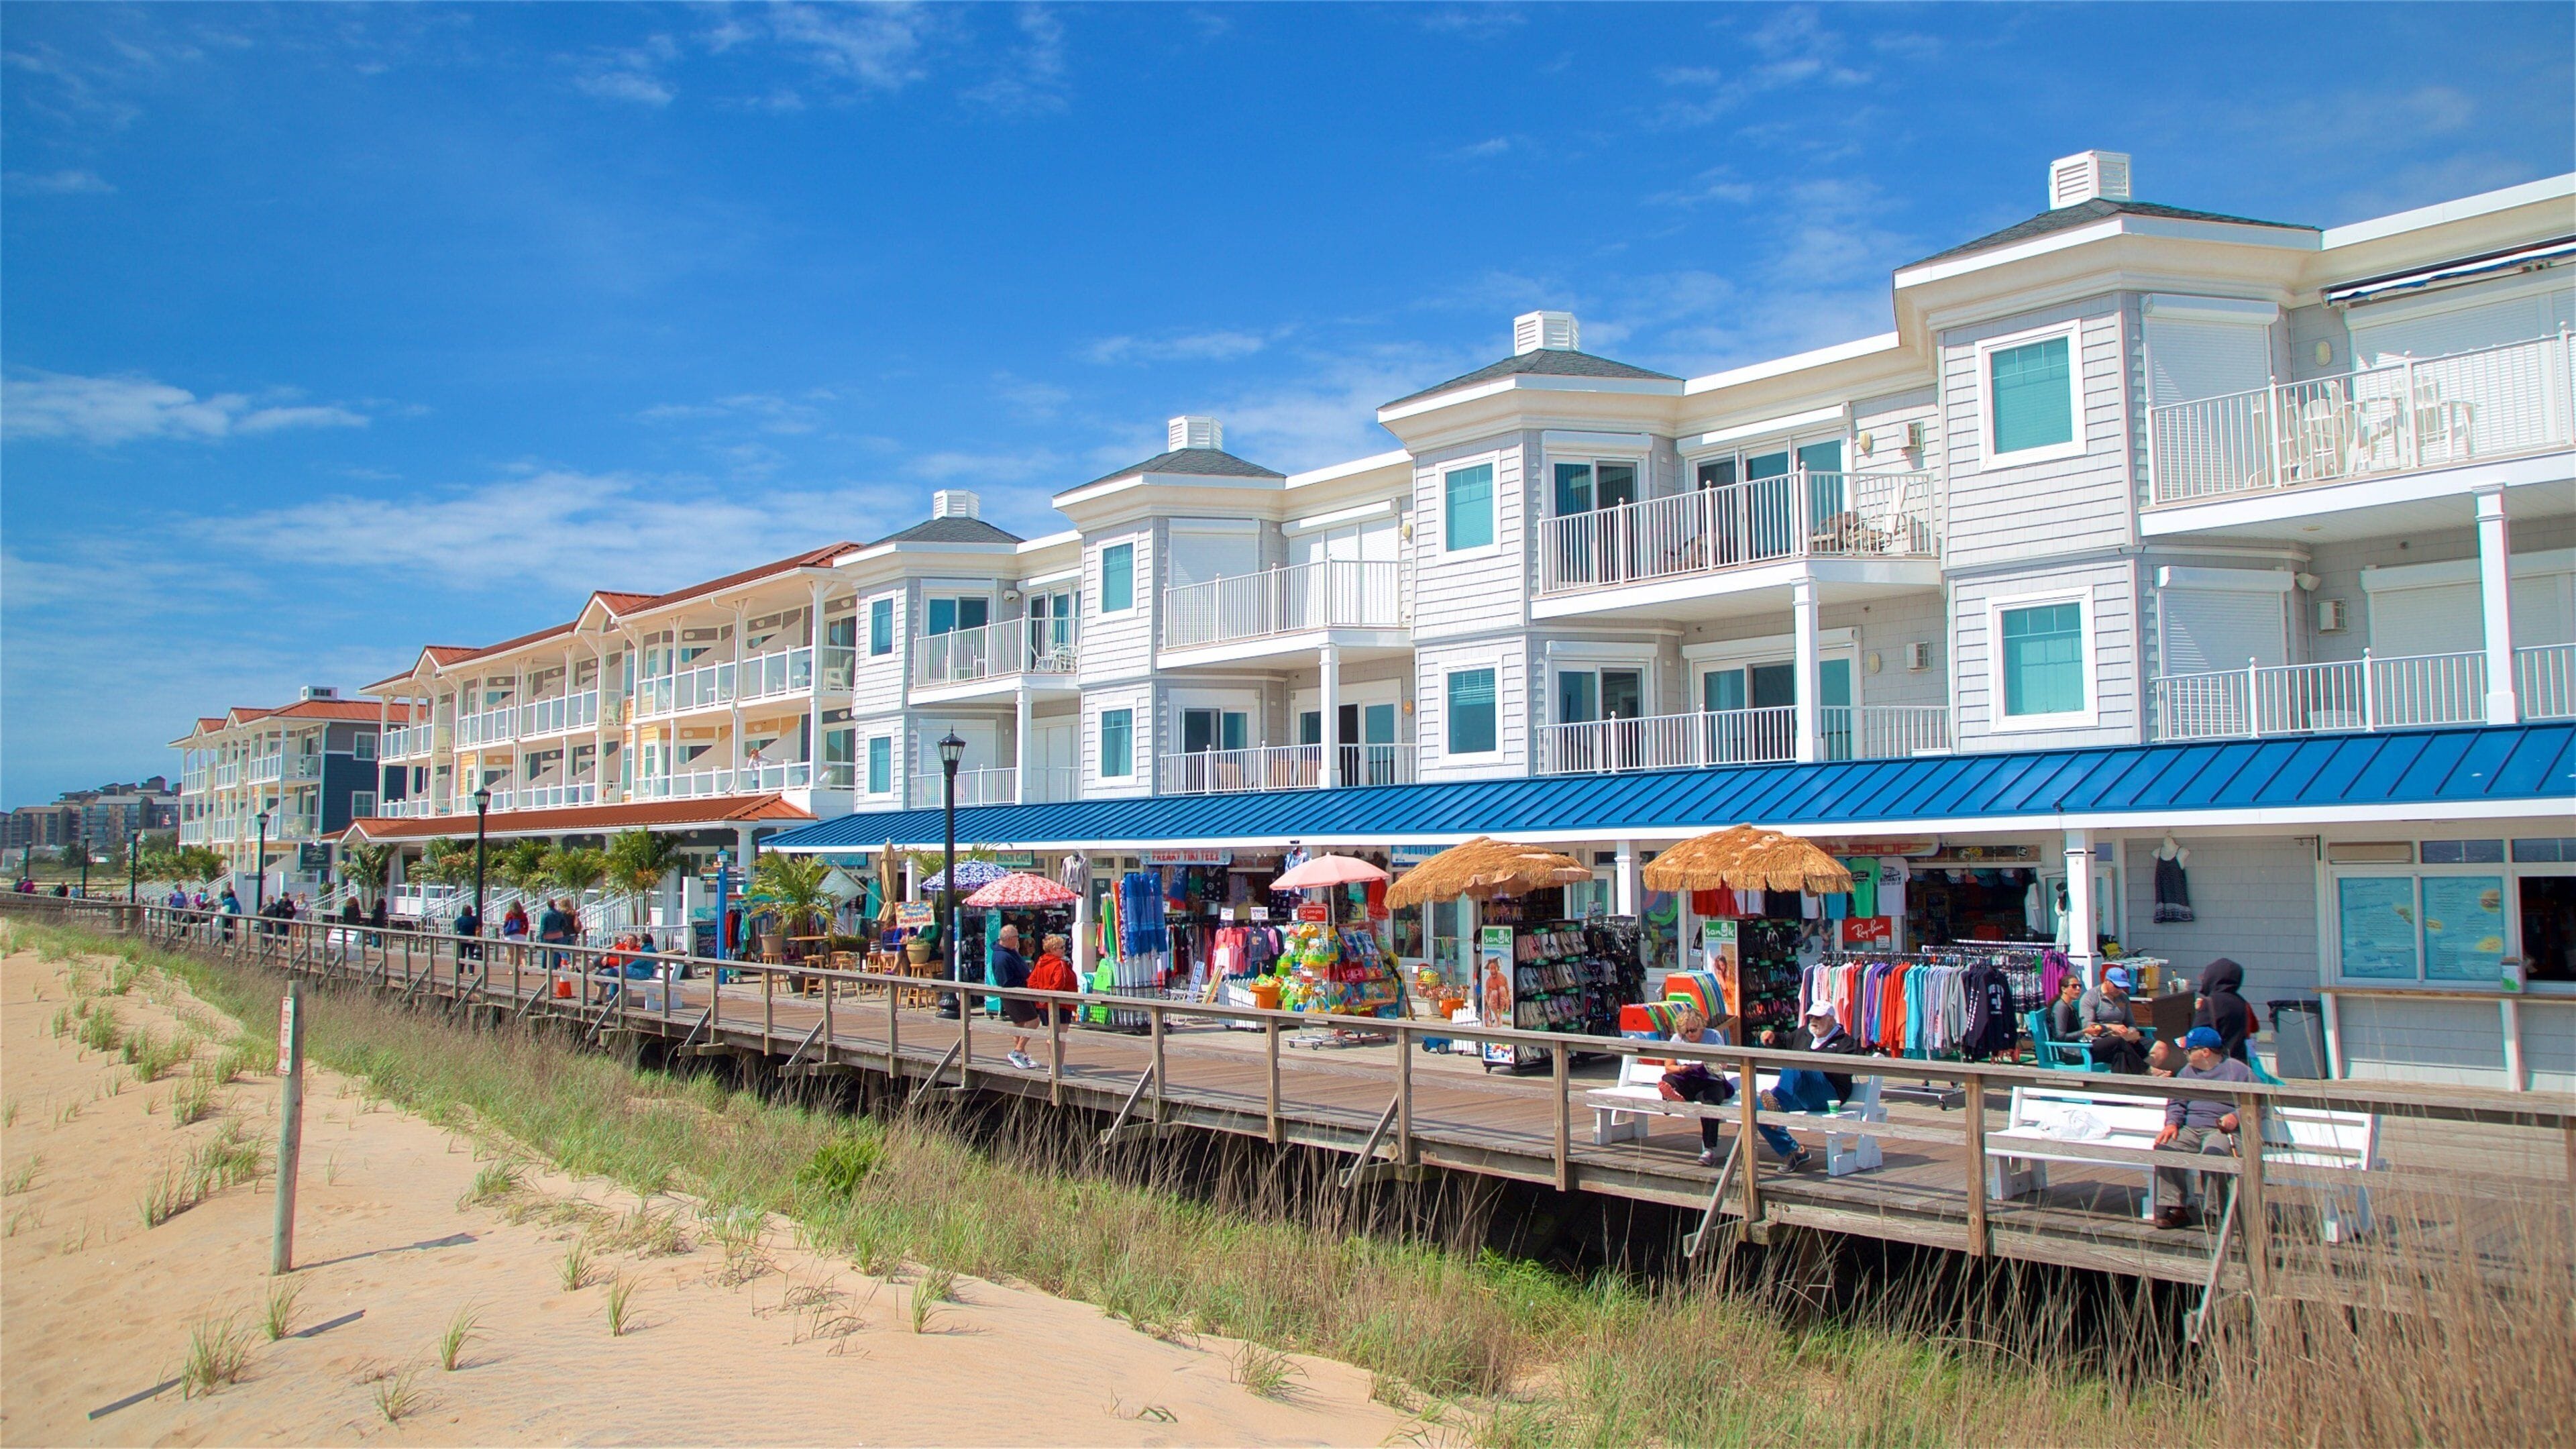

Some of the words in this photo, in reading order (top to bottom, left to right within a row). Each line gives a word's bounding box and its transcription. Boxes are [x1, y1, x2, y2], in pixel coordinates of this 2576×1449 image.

[1849, 843, 1914, 855] SHOP
[996, 852, 1014, 862] BEACH
[1152, 850, 1180, 861] FREAKY
[1183, 850, 1199, 861] TIKI
